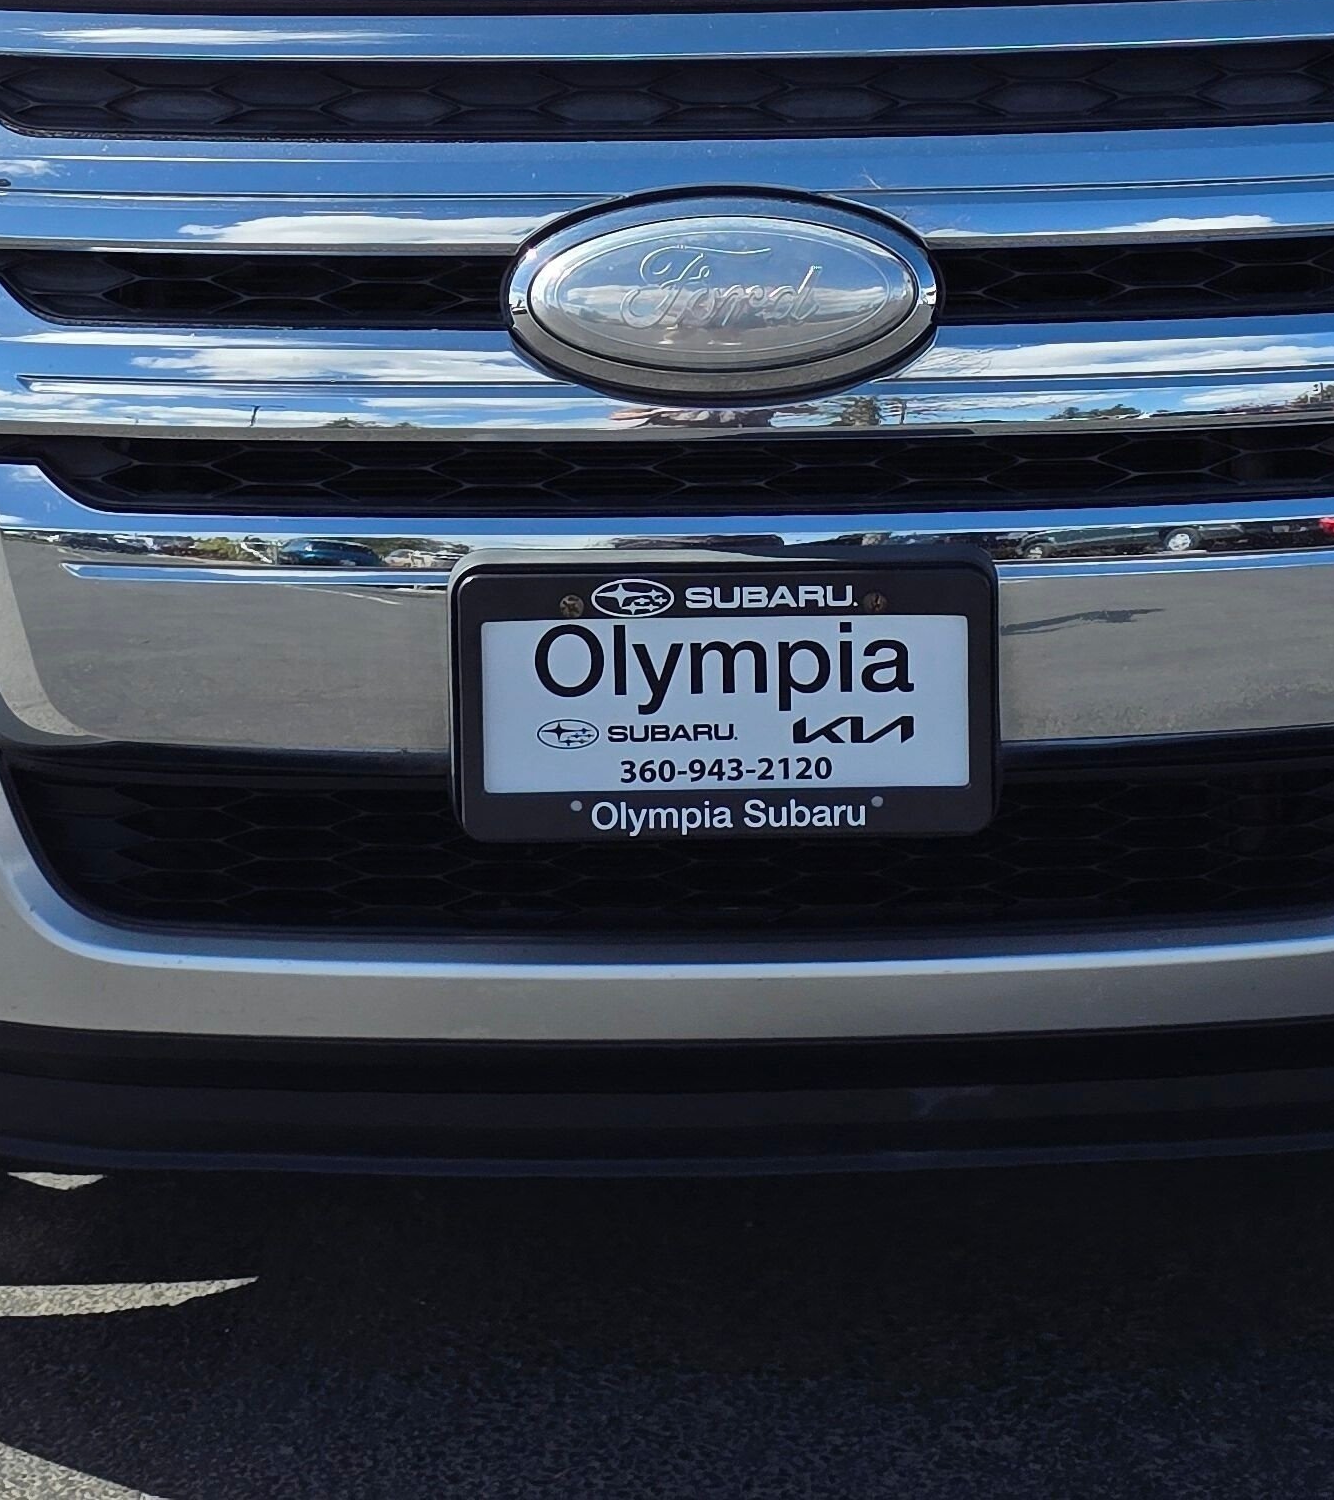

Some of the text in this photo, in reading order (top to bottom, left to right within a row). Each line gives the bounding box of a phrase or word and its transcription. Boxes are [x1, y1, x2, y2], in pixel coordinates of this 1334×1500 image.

[621, 244, 823, 328] Ford
[534, 622, 915, 715] Olympia
[619, 756, 833, 784] 360-943-2120
[590, 799, 867, 836] Olympia Subaru
